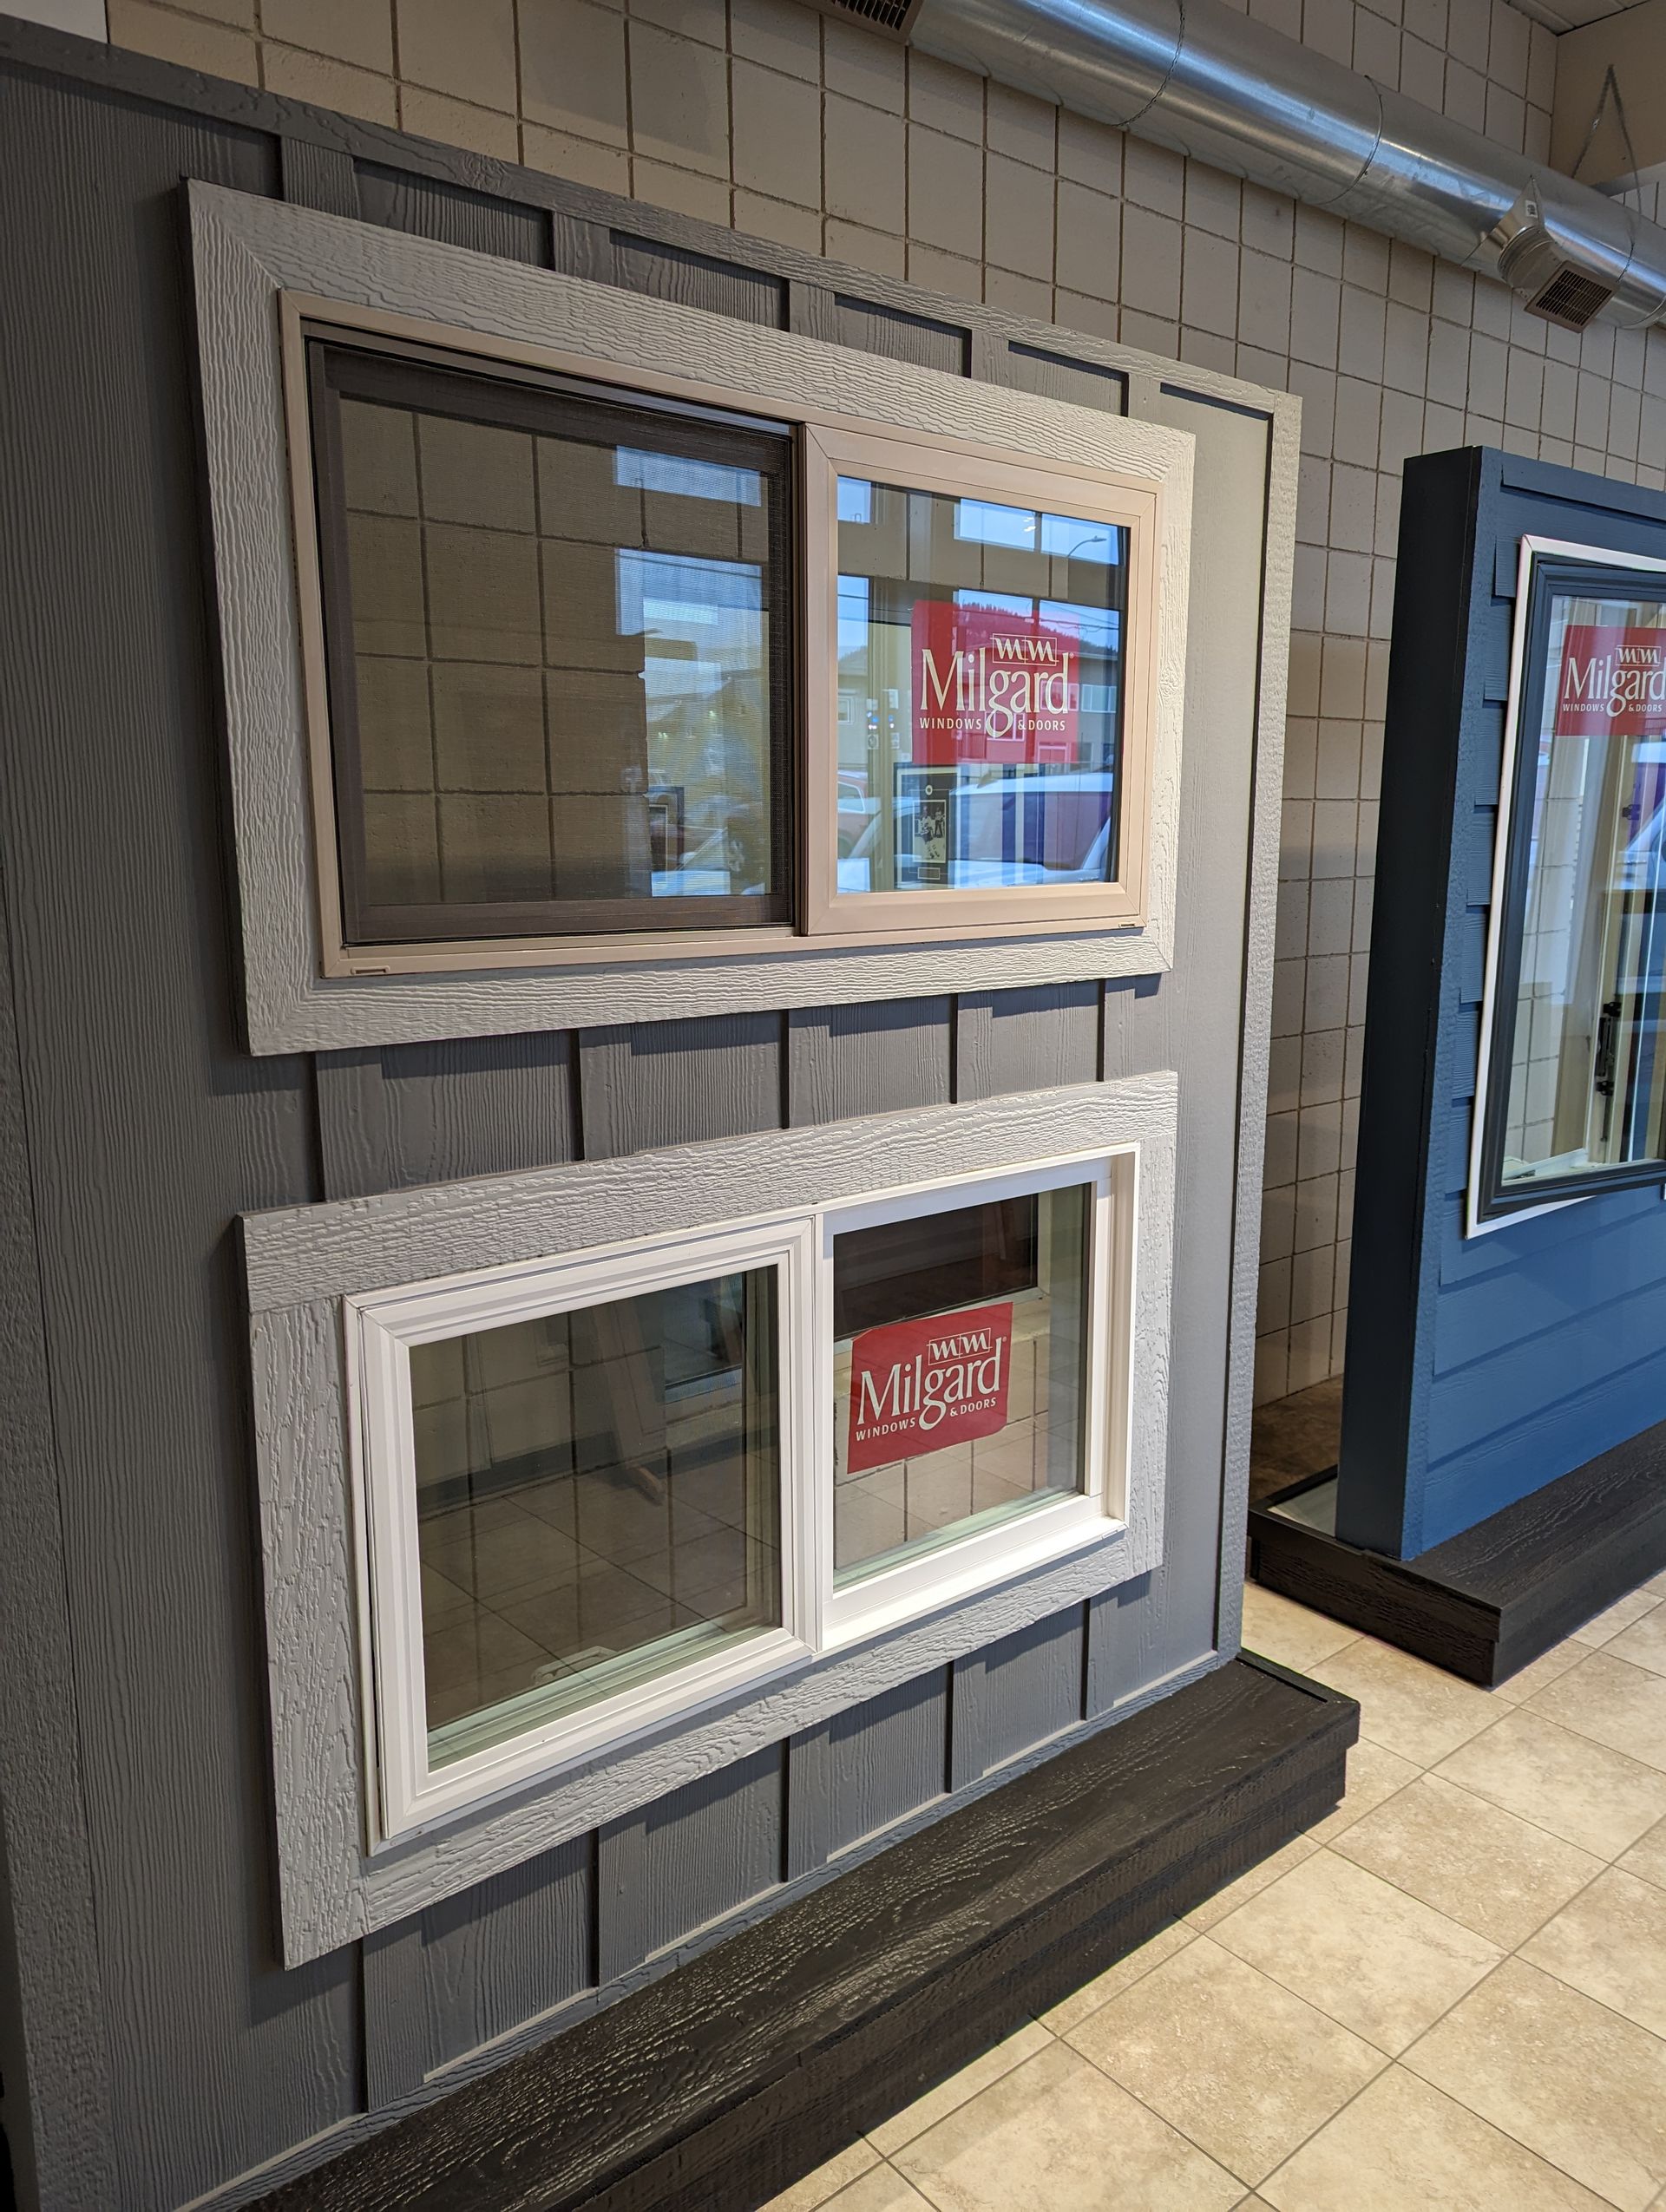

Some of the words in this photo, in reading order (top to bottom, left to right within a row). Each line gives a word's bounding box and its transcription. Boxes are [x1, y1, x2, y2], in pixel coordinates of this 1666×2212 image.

[920, 646, 1069, 738] Milgard
[1564, 655, 1666, 717] Milgard
[919, 717, 982, 730] WINDOWS
[1018, 720, 1026, 730] &
[1028, 720, 1066, 730] DOORS
[857, 1337, 1002, 1430] Milgard
[856, 1417, 915, 1441] WINDOWS
[949, 1408, 958, 1417] &
[960, 1397, 997, 1416] DOORS
